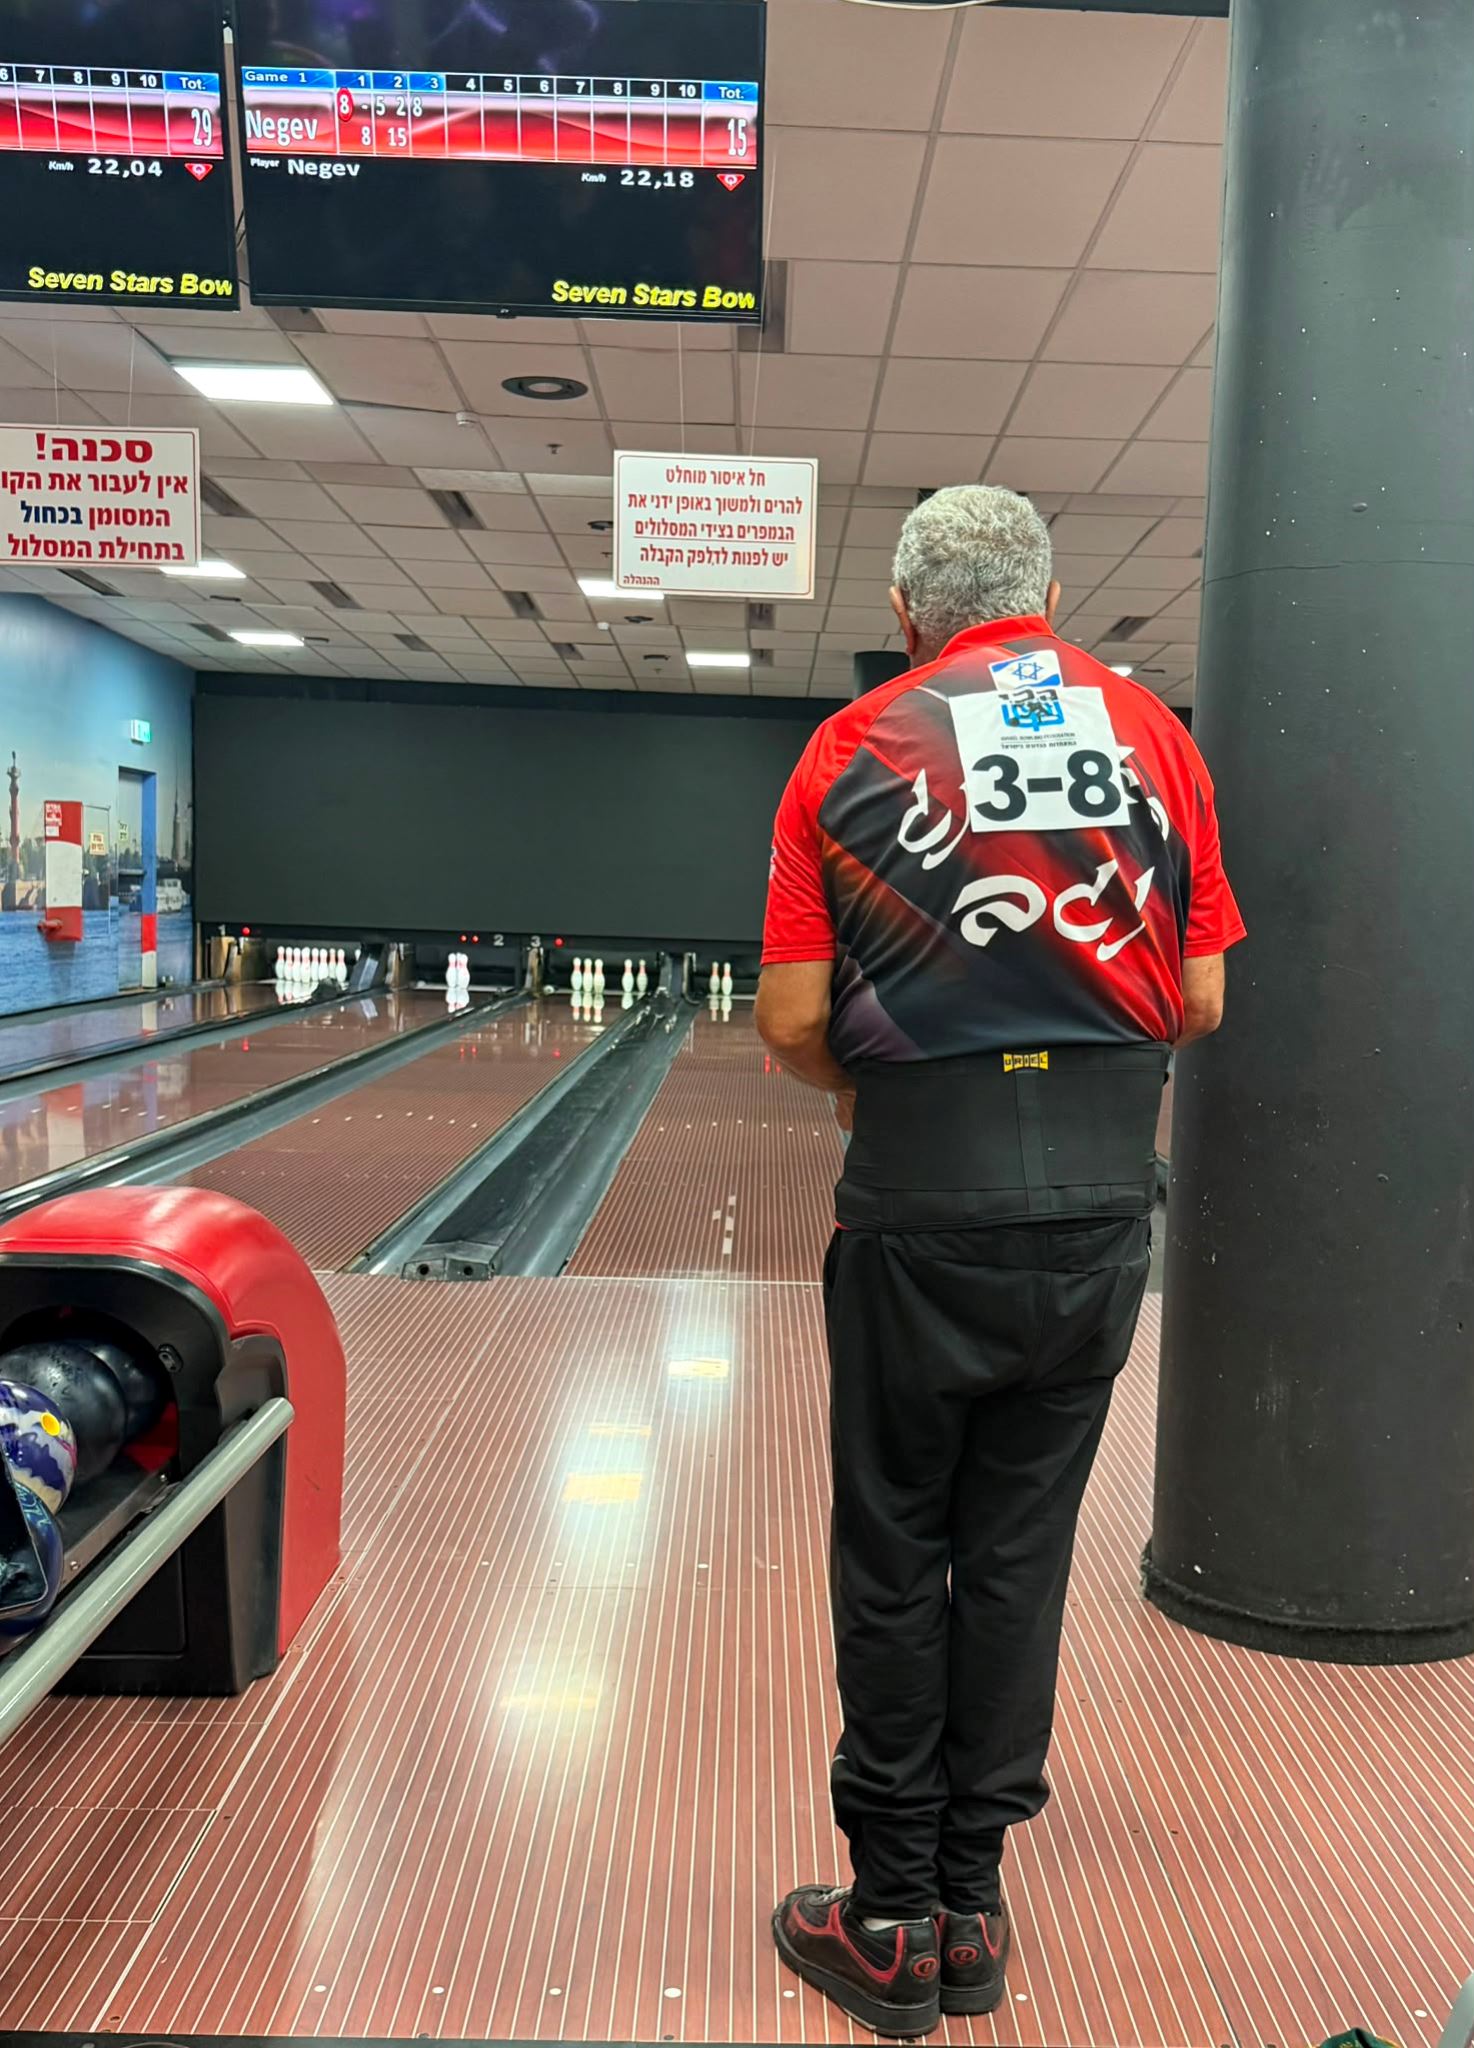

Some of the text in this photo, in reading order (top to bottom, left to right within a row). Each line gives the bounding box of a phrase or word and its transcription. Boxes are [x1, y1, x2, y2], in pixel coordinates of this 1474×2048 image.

[0, 67, 206, 90] 6 7 8 9 10 Tot.
[244, 71, 745, 99] Game 1 1 2 3 4 5 6 7 8 9 10 Tot.
[339, 94, 350, 115] 8
[375, 95, 386, 116] 5
[396, 96, 406, 117] 2
[412, 96, 423, 118] 8
[191, 108, 213, 147] 29
[245, 110, 747, 157] Negev 8 15 15
[48, 158, 163, 178] Km/h 22,04
[250, 157, 361, 179] Player Negev
[581, 170, 694, 190] Km/h 22,18
[28, 266, 233, 296] Seven Stars Bow
[552, 280, 755, 309] Seven Stars Bow
[35, 432, 154, 464] סכנה!
[1, 469, 189, 500] אין לעבור את הקו
[666, 465, 766, 486] חל איסור מוחלט
[20, 499, 171, 532] המסומן בכחול
[628, 493, 803, 515] להרים ולמשוך באופן ידני את
[634, 517, 795, 541] הבמפרים בצידי המסלולים
[7, 532, 185, 561] בתחילת המסלול
[639, 544, 788, 567] יש לפנות לדלפק הקבלה
[623, 573, 660, 586] ההנהלה
[971, 749, 1121, 822] 3-8
[493, 933, 505, 947] 2
[530, 935, 541, 948] 3
